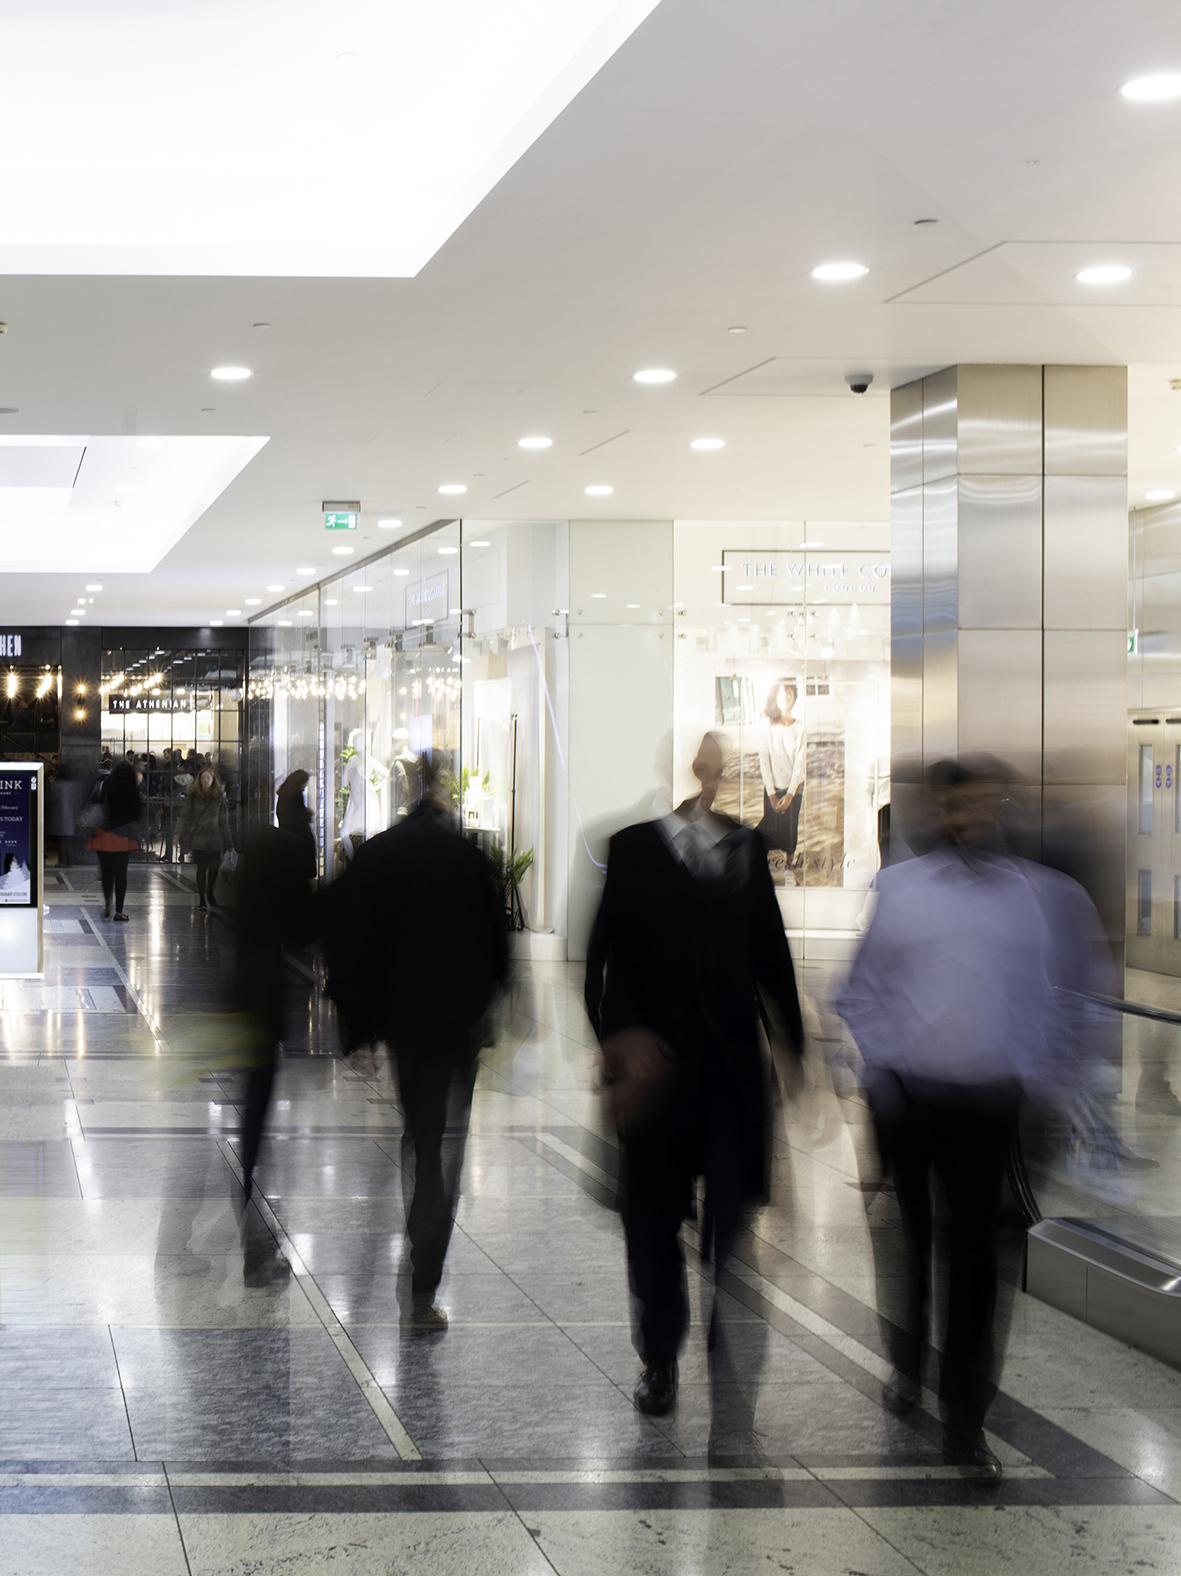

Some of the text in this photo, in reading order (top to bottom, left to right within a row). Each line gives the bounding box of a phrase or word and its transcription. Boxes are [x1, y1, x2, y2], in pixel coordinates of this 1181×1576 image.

[740, 562, 892, 579] THE WHITE CO
[823, 584, 876, 593] LONDON
[112, 699, 187, 709] THE ATHENIAN
[812, 852, 856, 877] style
